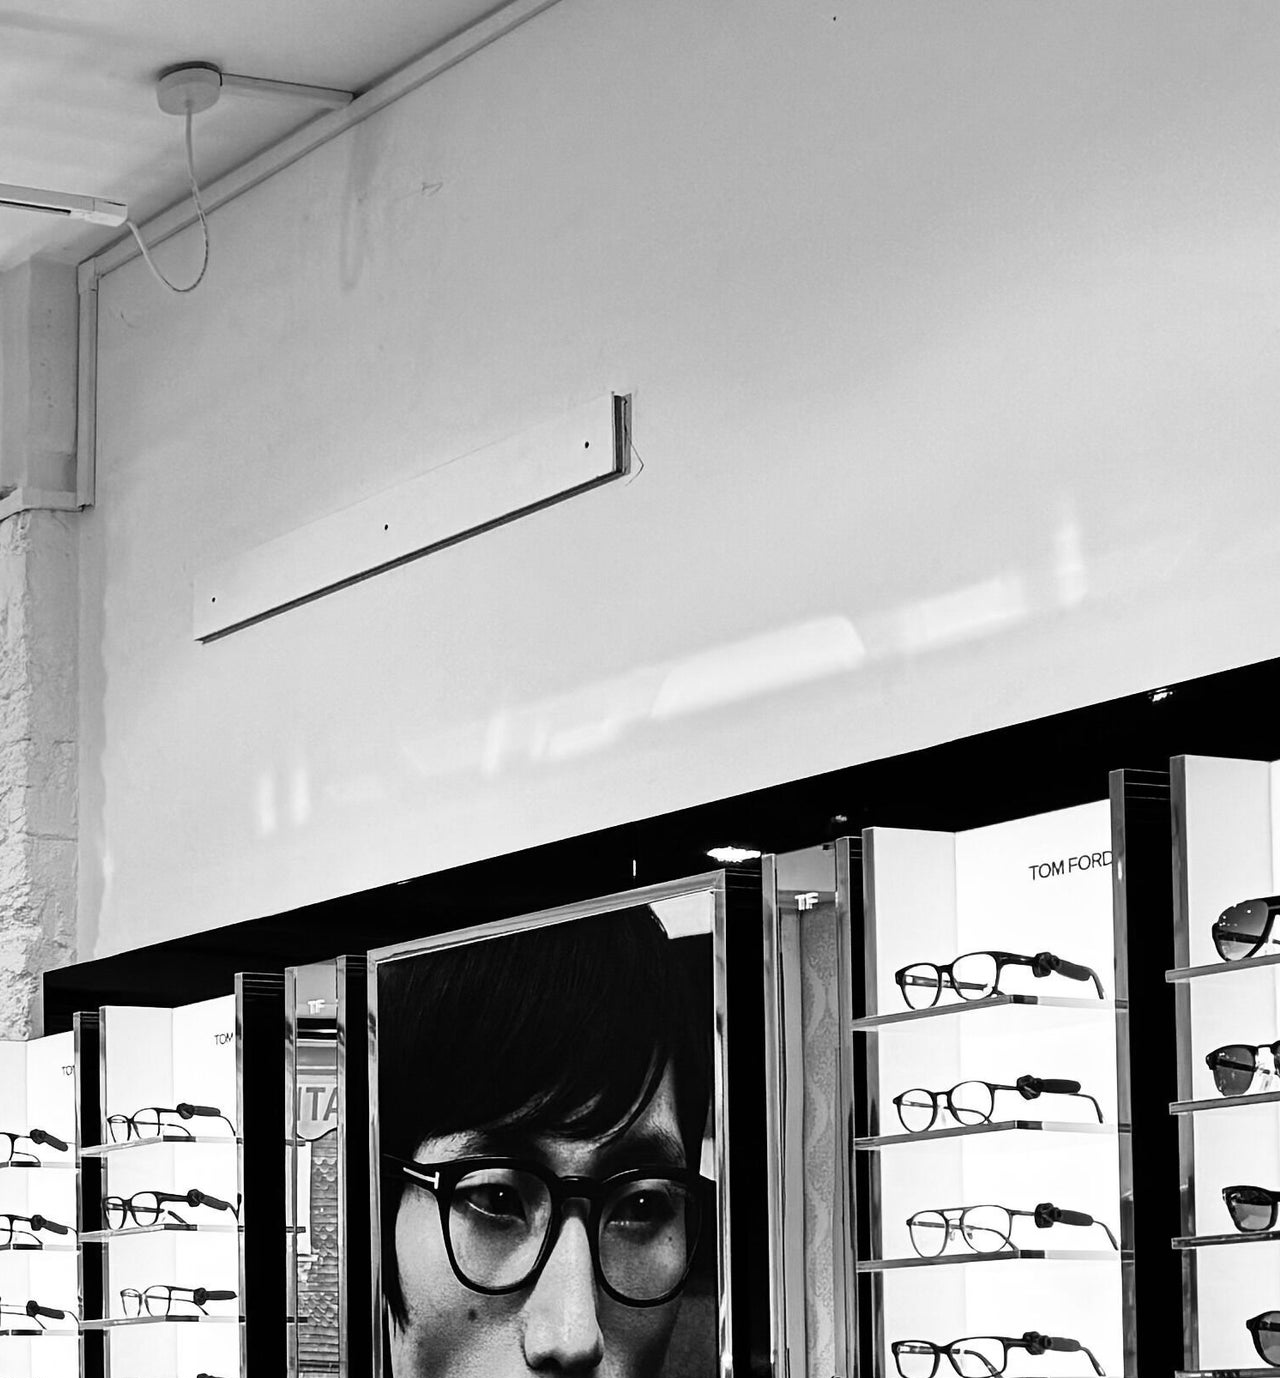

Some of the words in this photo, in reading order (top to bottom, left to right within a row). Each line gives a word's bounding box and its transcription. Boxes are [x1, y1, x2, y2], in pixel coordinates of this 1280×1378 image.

[1028, 859, 1065, 881] TOM
[1068, 850, 1113, 873] FORD
[794, 892, 819, 911] TF
[61, 1064, 75, 1076] TO
